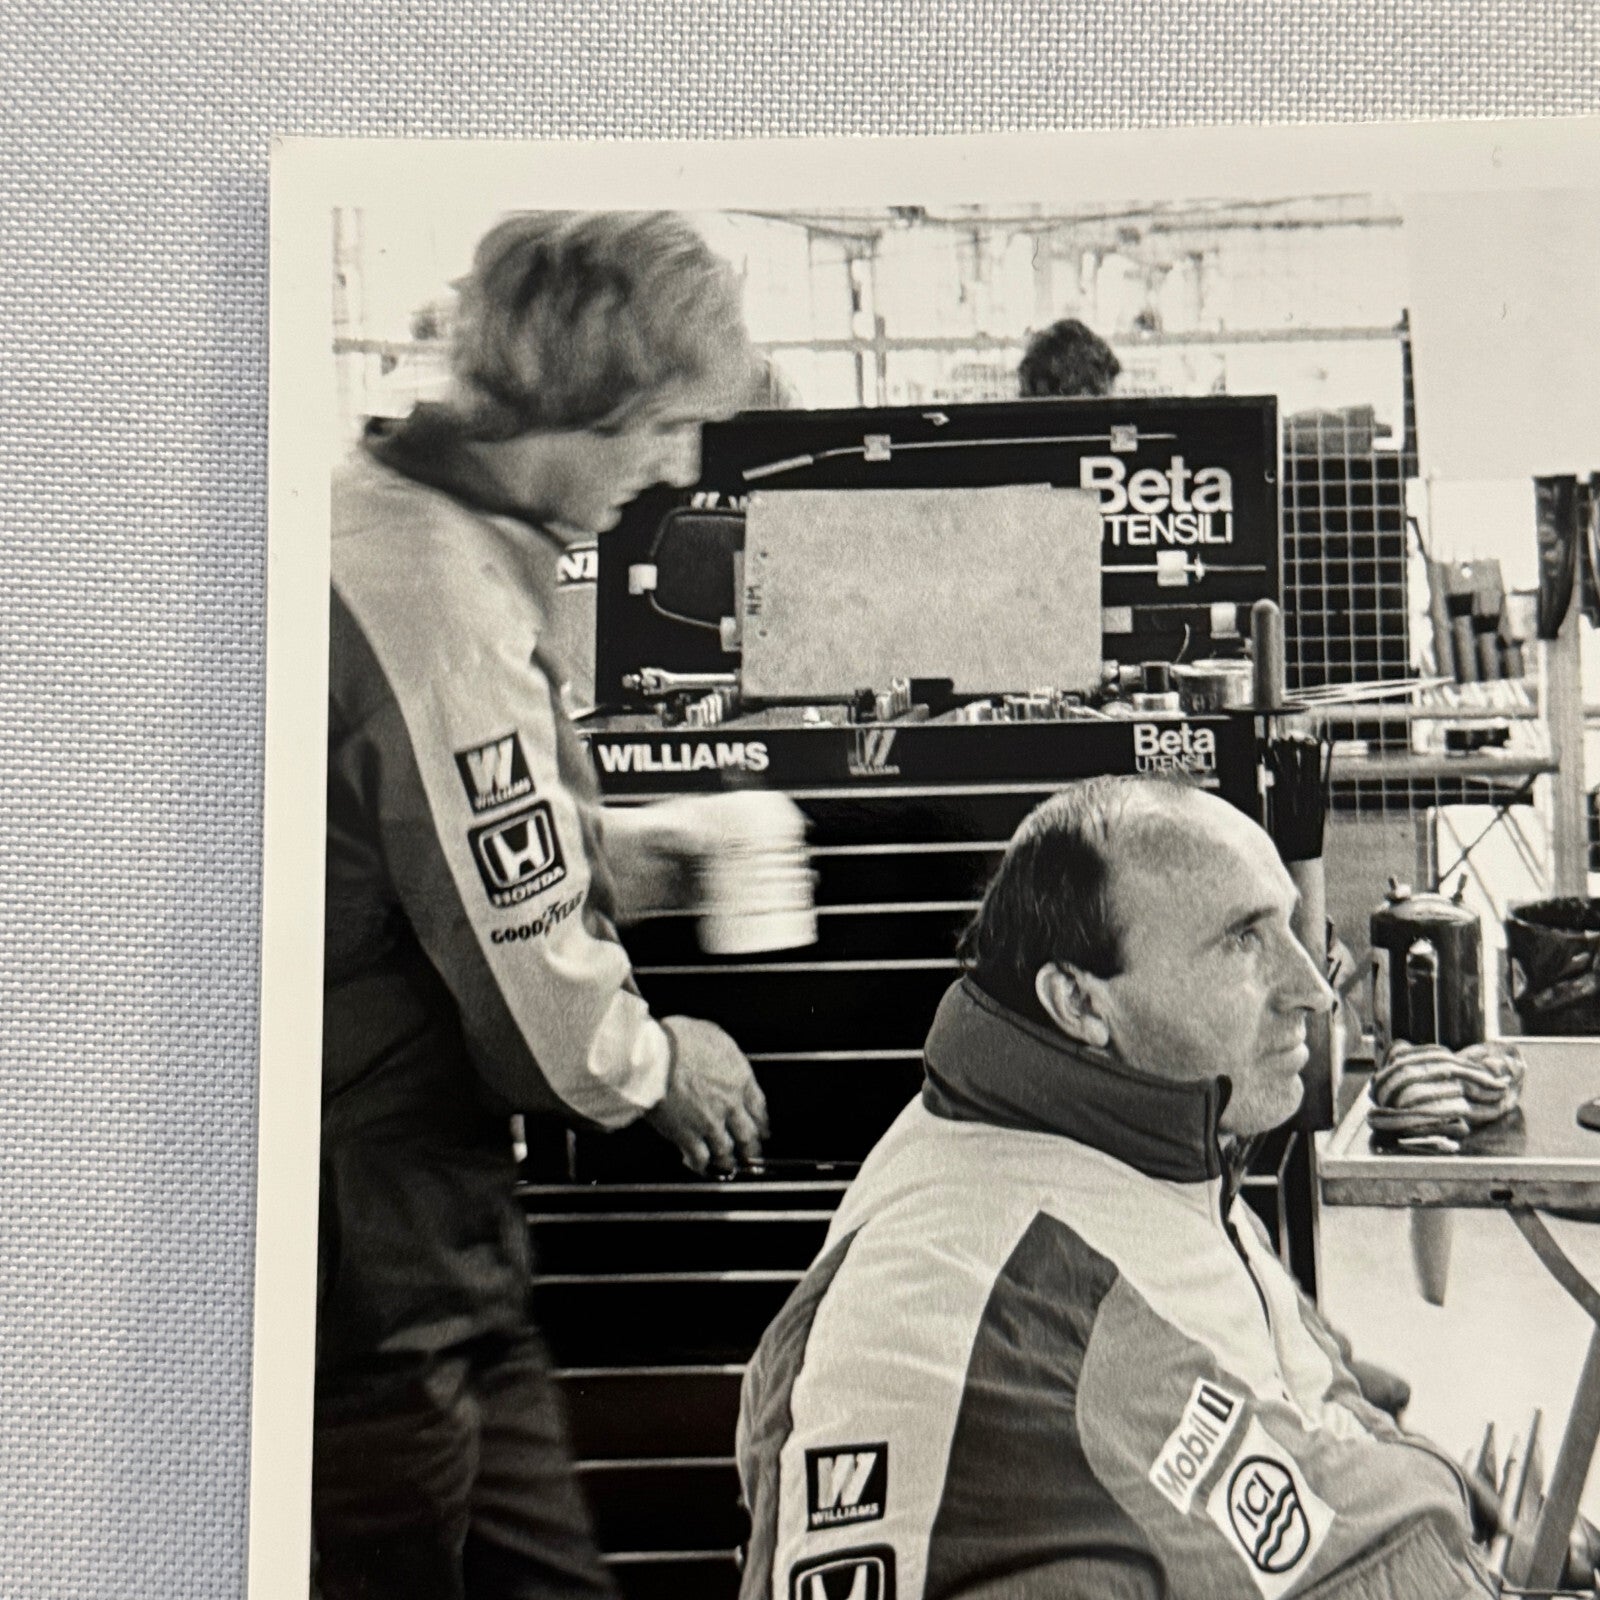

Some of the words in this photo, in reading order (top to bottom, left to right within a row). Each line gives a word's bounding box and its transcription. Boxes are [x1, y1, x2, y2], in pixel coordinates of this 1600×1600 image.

[1080, 455, 1233, 513] Beta
[1100, 512, 1233, 546] TENSILI
[1133, 722, 1216, 756] Beta
[598, 742, 769, 772] WILLIAMS
[1156, 1412, 1221, 1497] Mobil
[811, 1502, 880, 1526] WILLIAMS
[1235, 1469, 1276, 1531] ICI
